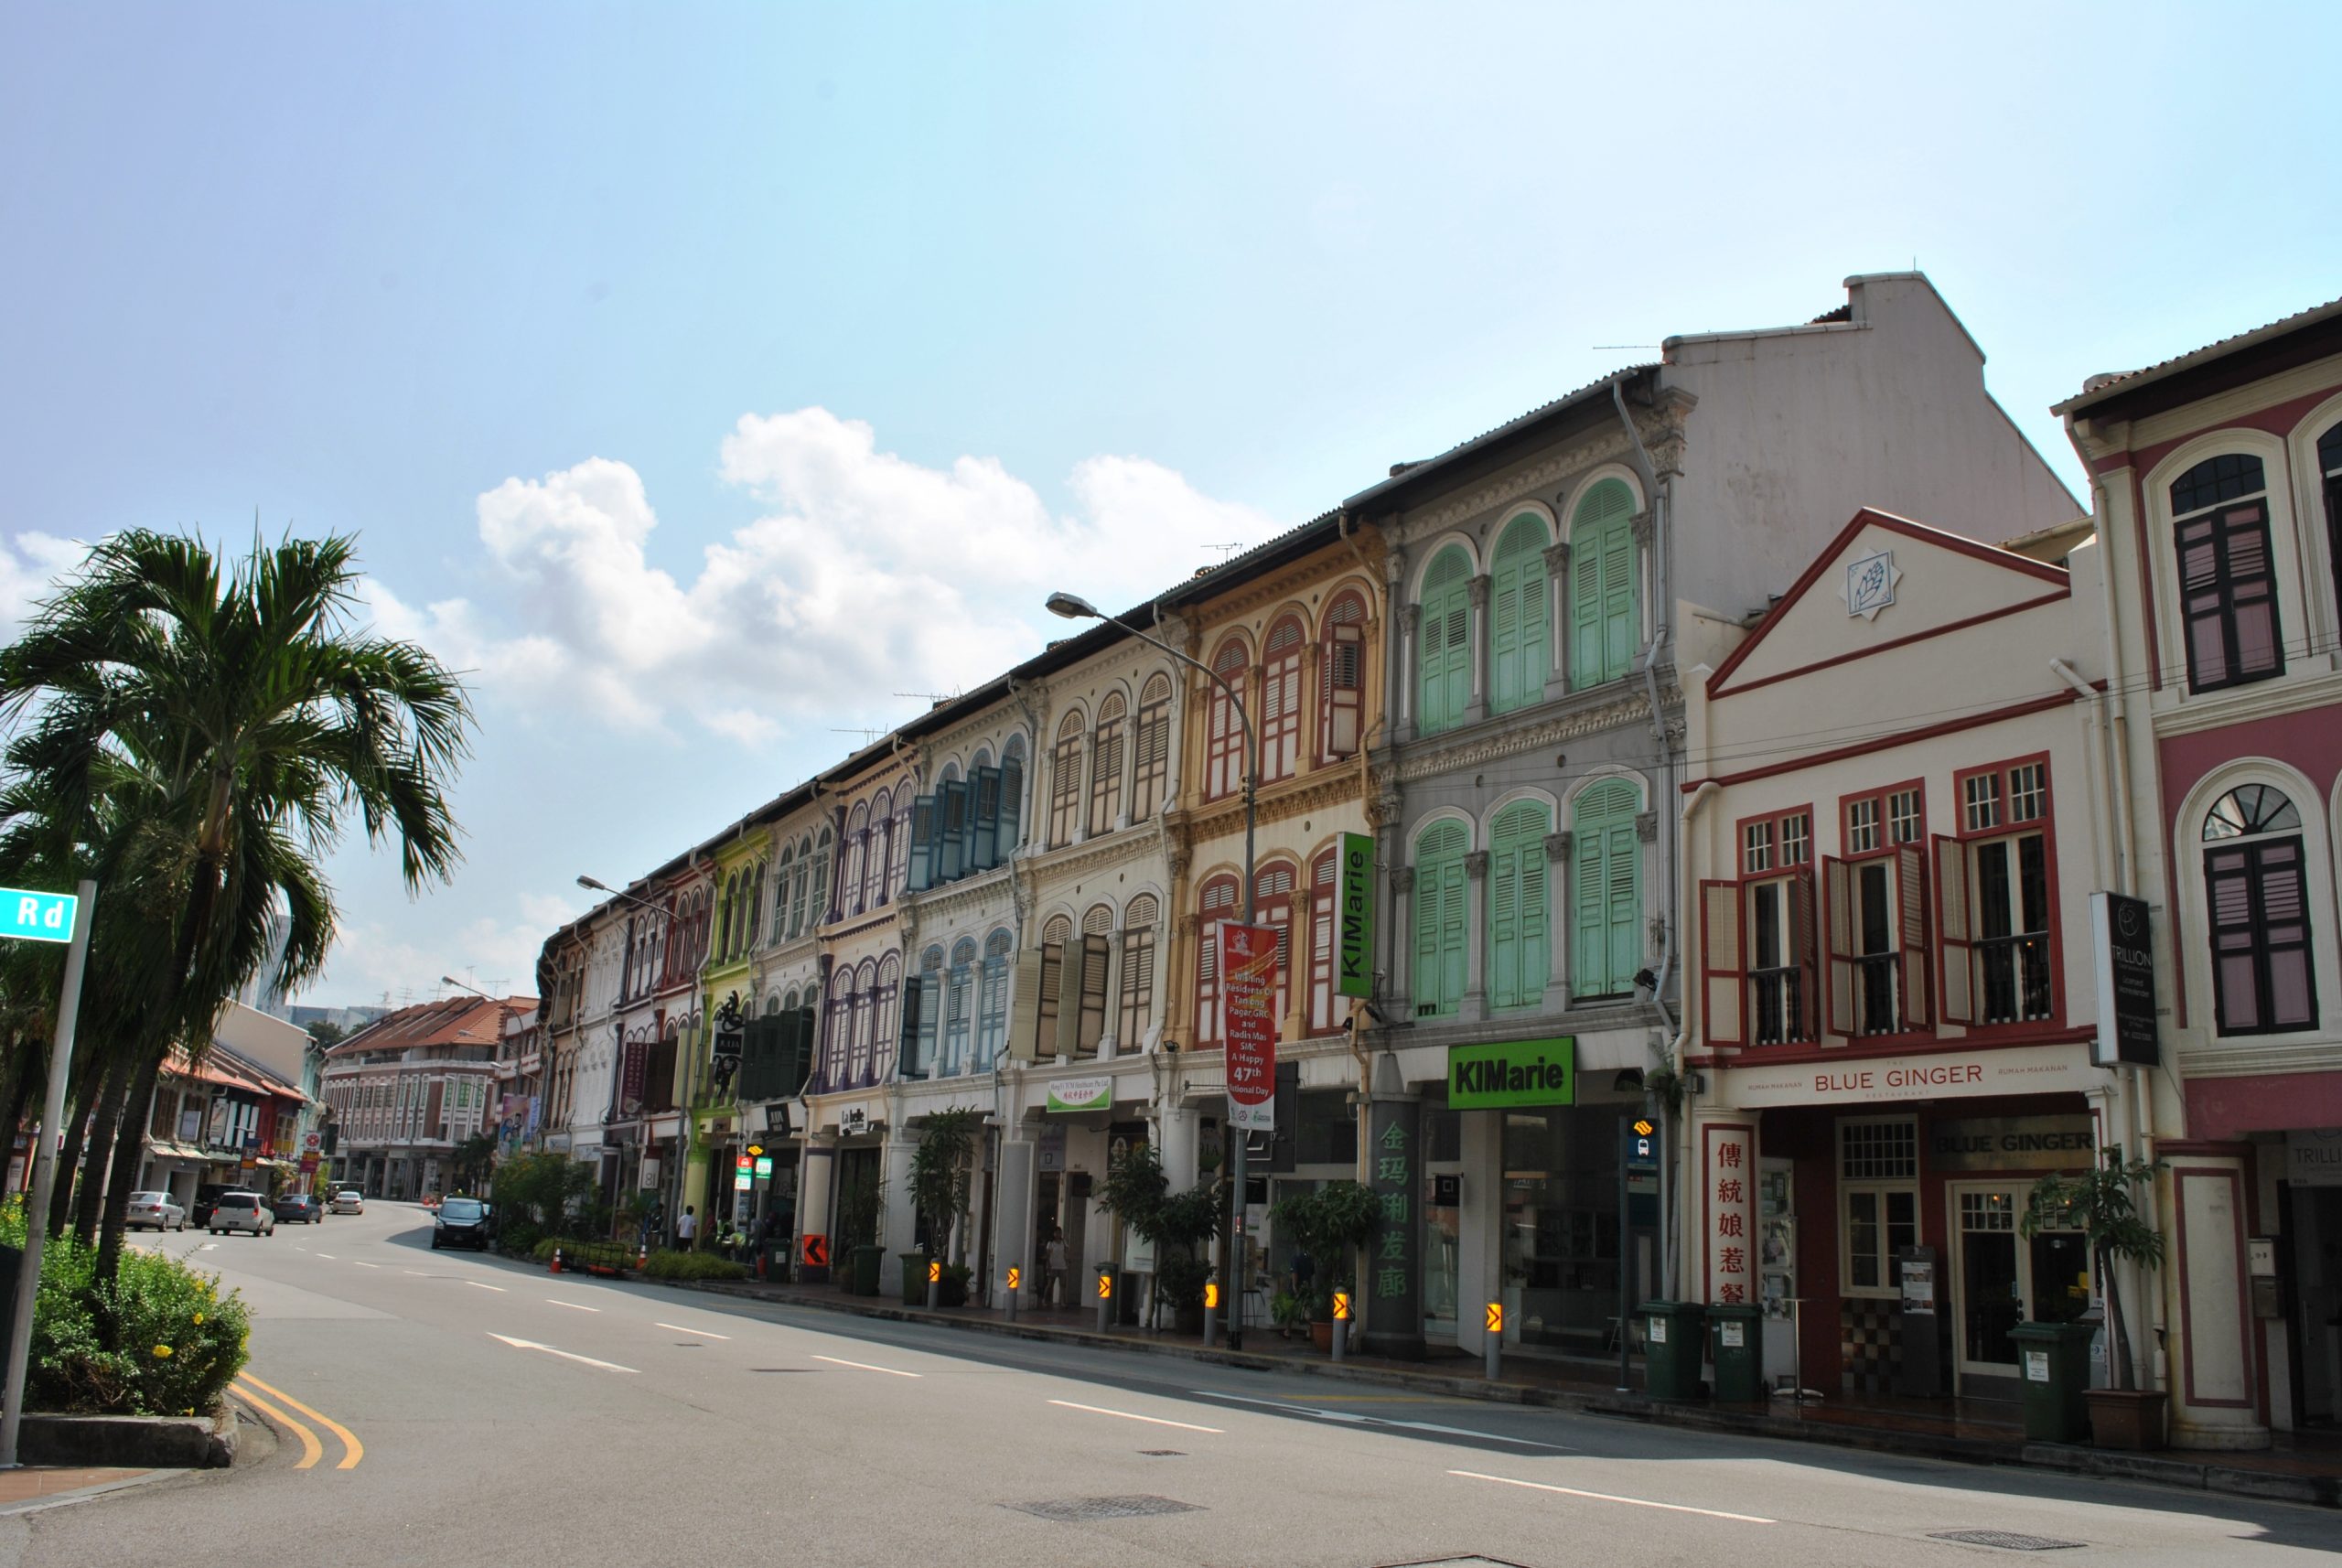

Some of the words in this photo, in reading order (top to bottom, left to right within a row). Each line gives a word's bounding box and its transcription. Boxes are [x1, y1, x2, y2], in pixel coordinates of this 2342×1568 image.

[17, 897, 65, 929] Rd
[1342, 849, 1364, 978] KIMarie
[2111, 944, 2152, 967] TRILLION
[1235, 972, 1265, 985] Wishing
[1226, 983, 1262, 995] Residents
[1241, 1020, 1256, 1029] and
[1230, 1029, 1251, 1039] Radin
[1252, 1032, 1267, 1041] Mas
[1240, 1042, 1257, 1051] SMC
[1231, 1053, 1238, 1061] A
[1240, 1053, 1263, 1065] Happy
[1233, 1067, 1262, 1081] 47th
[1456, 1056, 1563, 1093] KIMarie
[1998, 1068, 2025, 1076] RUMAH
[2027, 1065, 2068, 1074] MAKANAN
[1815, 1072, 1874, 1091] BLUE
[1886, 1065, 1982, 1088] GINGER
[1255, 1086, 1269, 1097] Day
[1936, 1135, 1993, 1154] BLUE
[2001, 1132, 2092, 1152] GINGER
